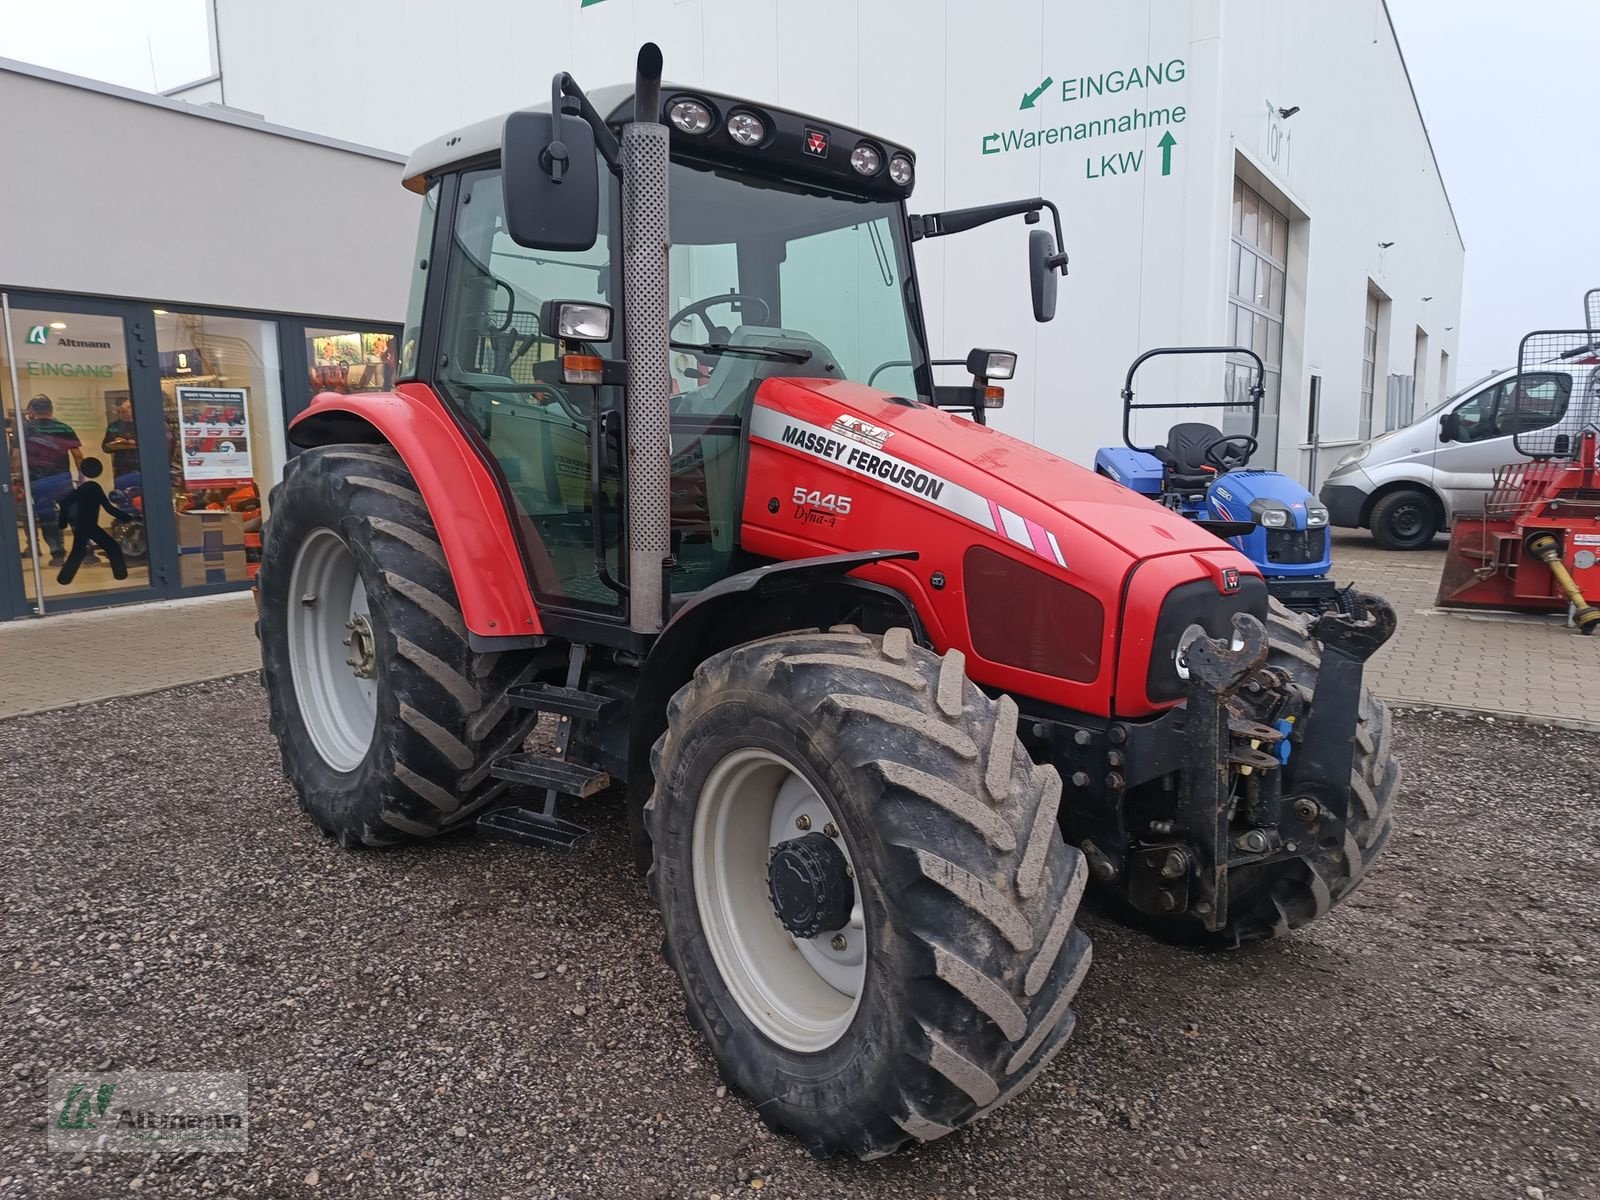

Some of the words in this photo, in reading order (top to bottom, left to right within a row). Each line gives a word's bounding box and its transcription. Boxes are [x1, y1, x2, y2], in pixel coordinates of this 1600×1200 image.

[1062, 59, 1186, 102] EINGANG
[1001, 106, 1186, 152] Warenannahme
[1086, 149, 1144, 179] LKW
[57, 337, 112, 349] Altmann
[27, 361, 114, 378] EINGANG
[782, 425, 847, 461] MASSEY
[847, 447, 945, 501] FERGUSON
[792, 486, 852, 515] 5445
[794, 505, 837, 528] Dyna-4
